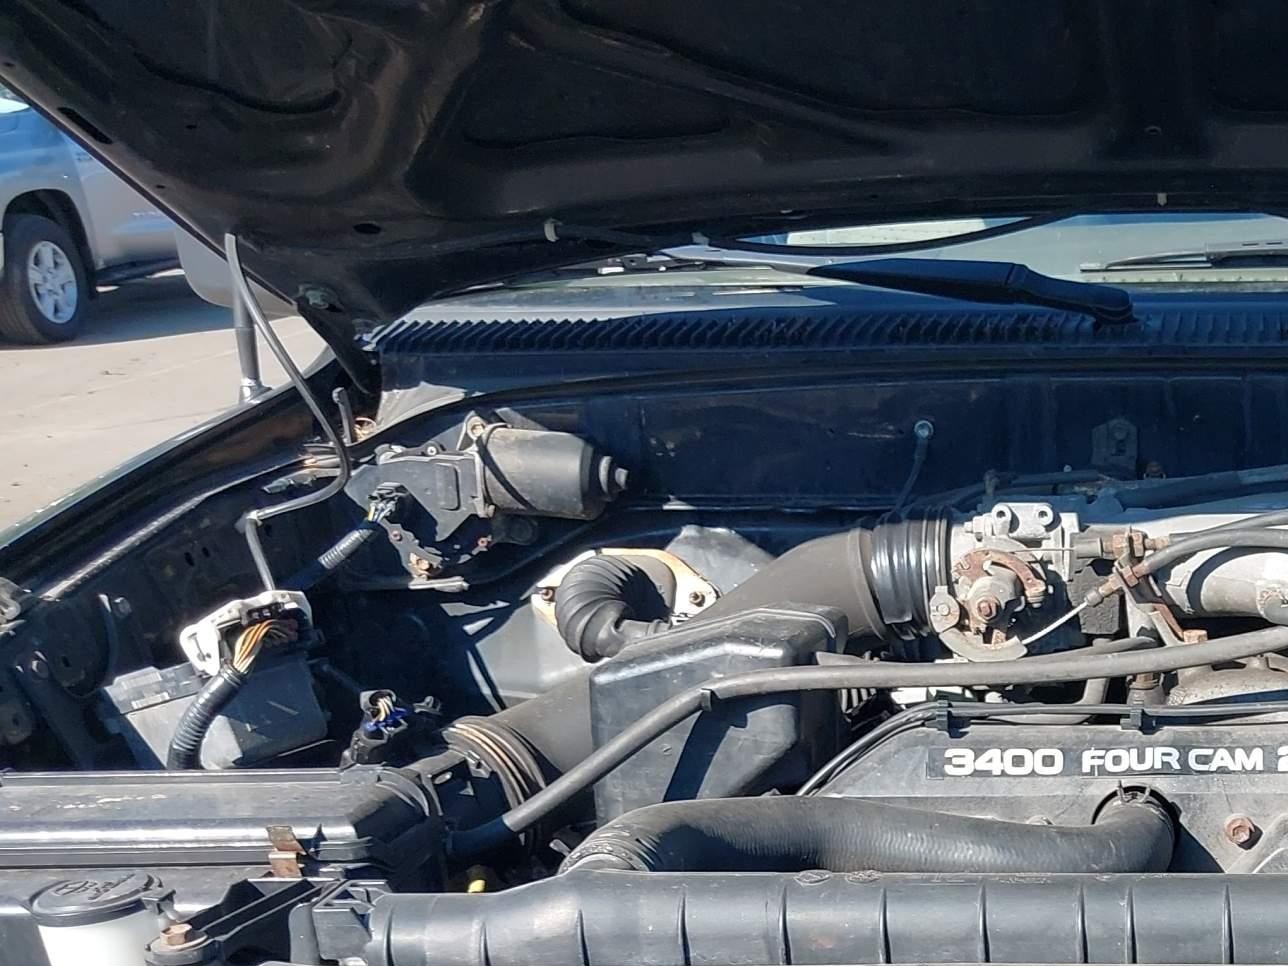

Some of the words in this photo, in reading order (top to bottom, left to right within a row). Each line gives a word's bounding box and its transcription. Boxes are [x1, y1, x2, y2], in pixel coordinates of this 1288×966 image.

[944, 748, 1064, 776] 3400
[1081, 746, 1182, 774] FOUR
[1187, 747, 1264, 772] CAM
